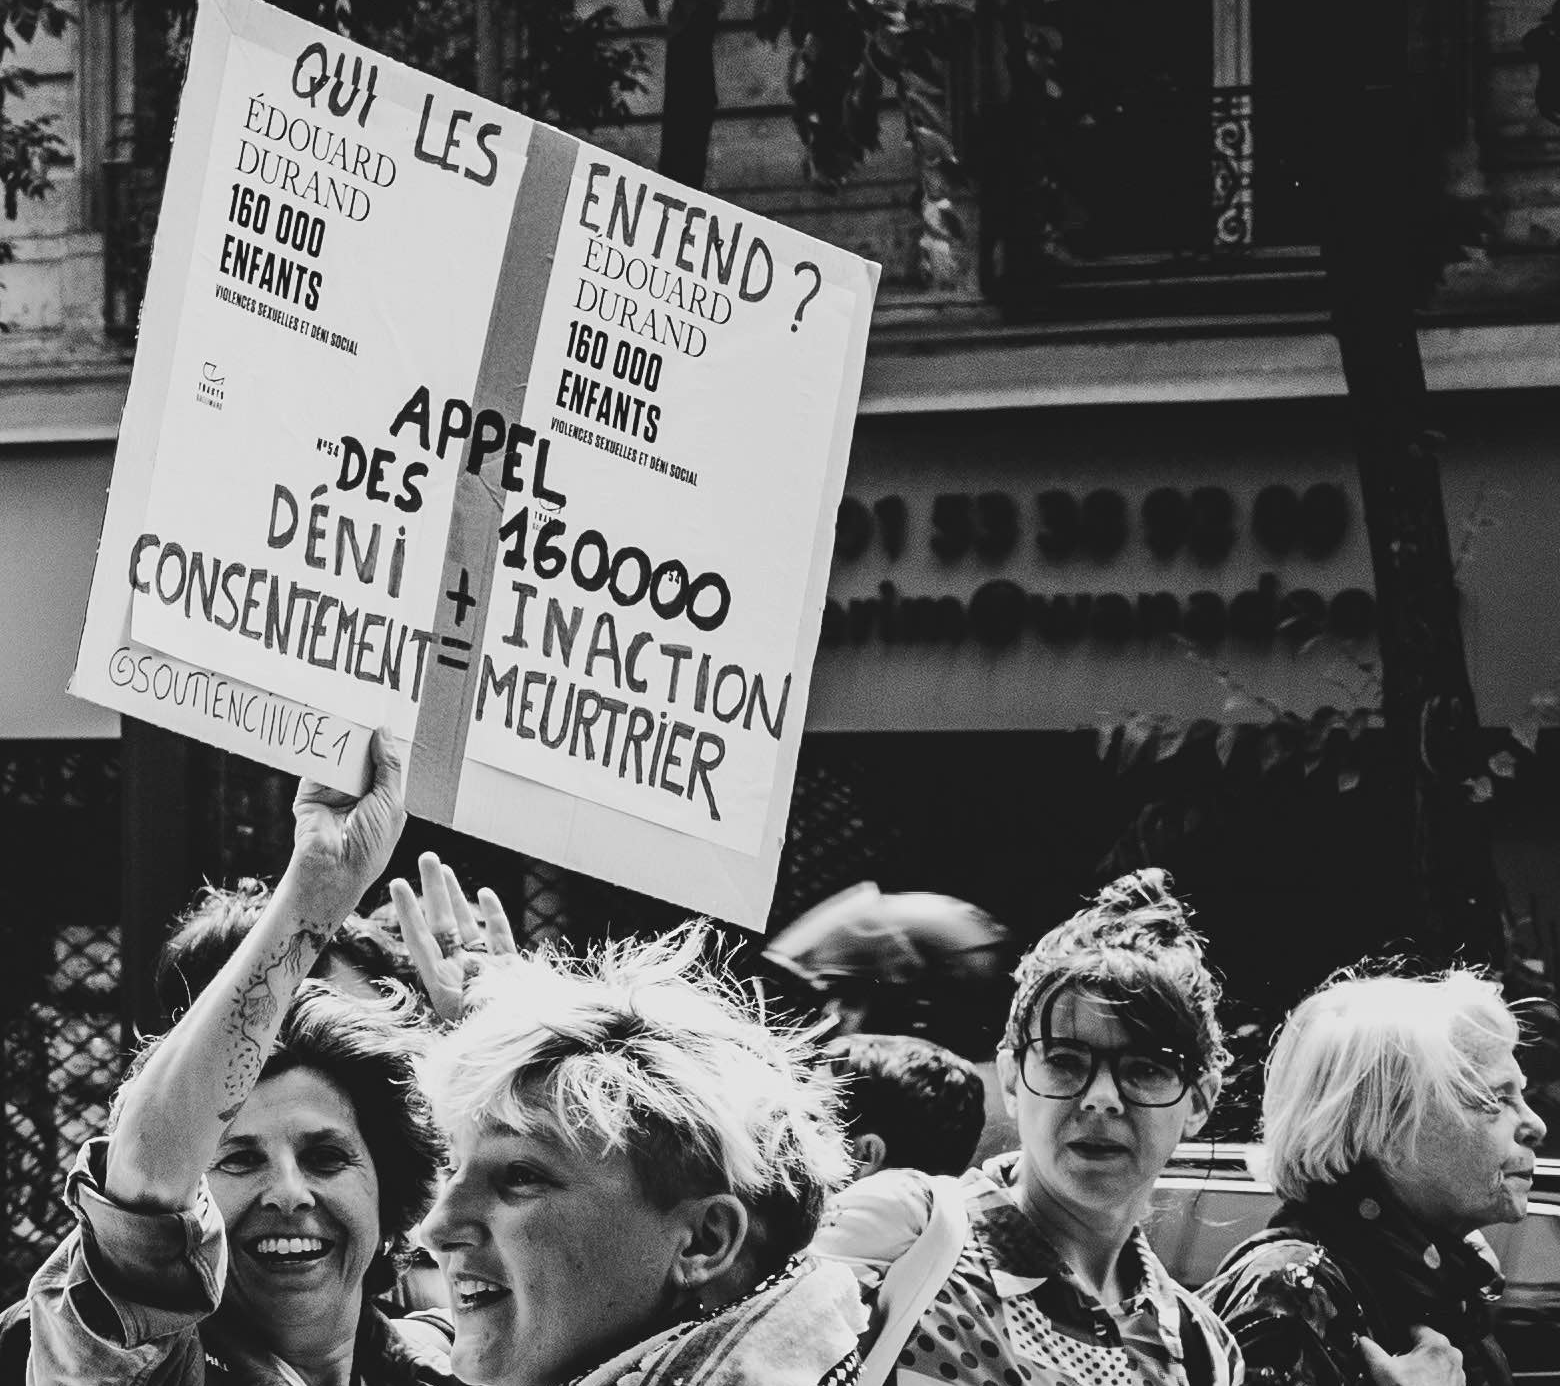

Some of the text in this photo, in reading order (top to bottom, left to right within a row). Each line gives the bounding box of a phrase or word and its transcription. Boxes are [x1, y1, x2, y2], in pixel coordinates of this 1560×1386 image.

[243, 94, 396, 188] ÉDOUARD
[292, 43, 502, 187] QUI LES
[228, 183, 326, 258] 160 000
[235, 140, 371, 222] DURAND
[219, 233, 323, 312] ENFANTS
[579, 163, 774, 303] ENTEND
[573, 277, 707, 358] DURAND
[583, 233, 732, 325] ÉDOUARD
[215, 284, 256, 314] VIOLENCES
[258, 301, 298, 332] SEXUELLES
[300, 316, 309, 334] ET
[330, 332, 359, 357] SOCIAL
[566, 320, 663, 393] 160 000
[390, 385, 566, 509] APPEL
[556, 368, 661, 444] ENFANTS
[550, 417, 593, 445] VIOLENCES
[595, 433, 637, 463] SEXUELLES
[639, 450, 648, 468] ET
[669, 464, 698, 488] SOCIAL
[336, 436, 429, 512] DES
[499, 507, 731, 632] 160000
[502, 580, 792, 741] INACTION
